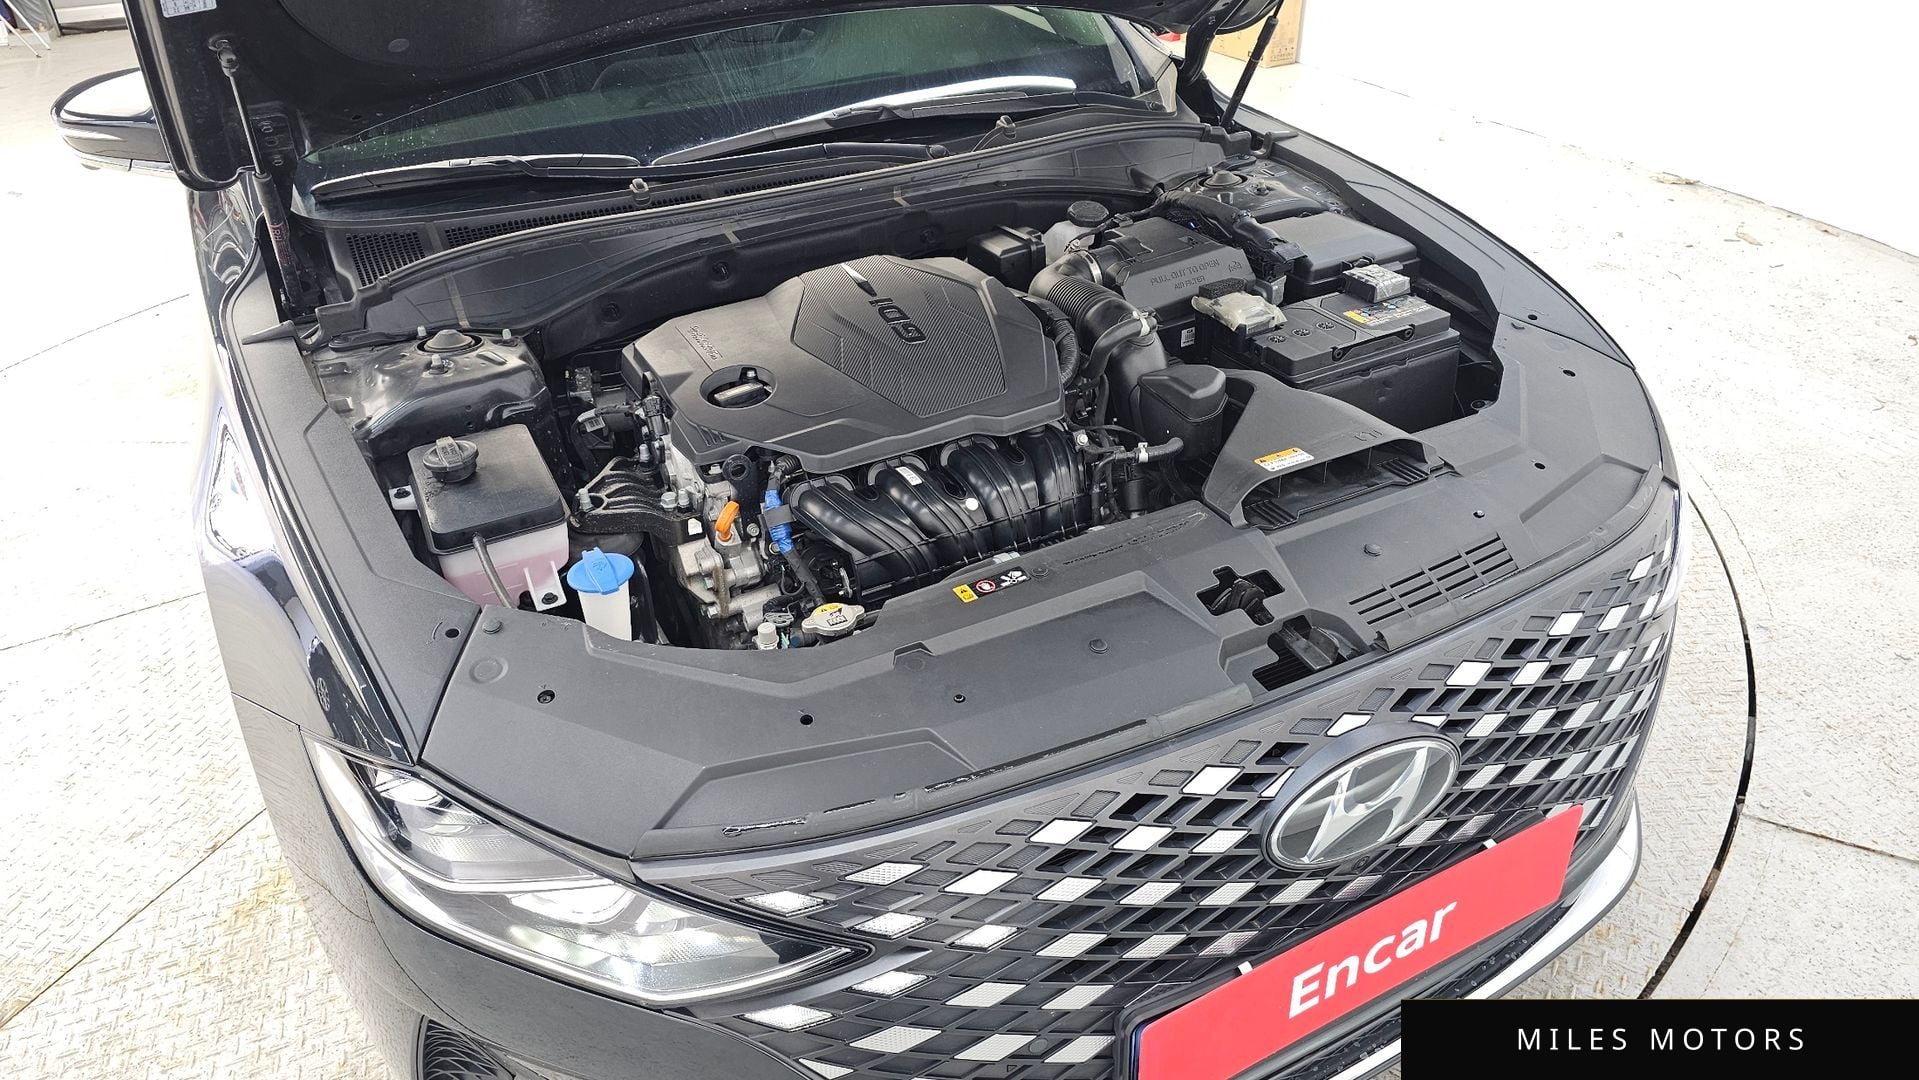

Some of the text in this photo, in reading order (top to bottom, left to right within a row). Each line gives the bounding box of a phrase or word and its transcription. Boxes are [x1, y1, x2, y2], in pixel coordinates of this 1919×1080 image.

[1150, 258, 1221, 286] PULL OUT TO OPEN
[1184, 275, 1206, 288] FILTER
[1288, 901, 1458, 1020] Encar
